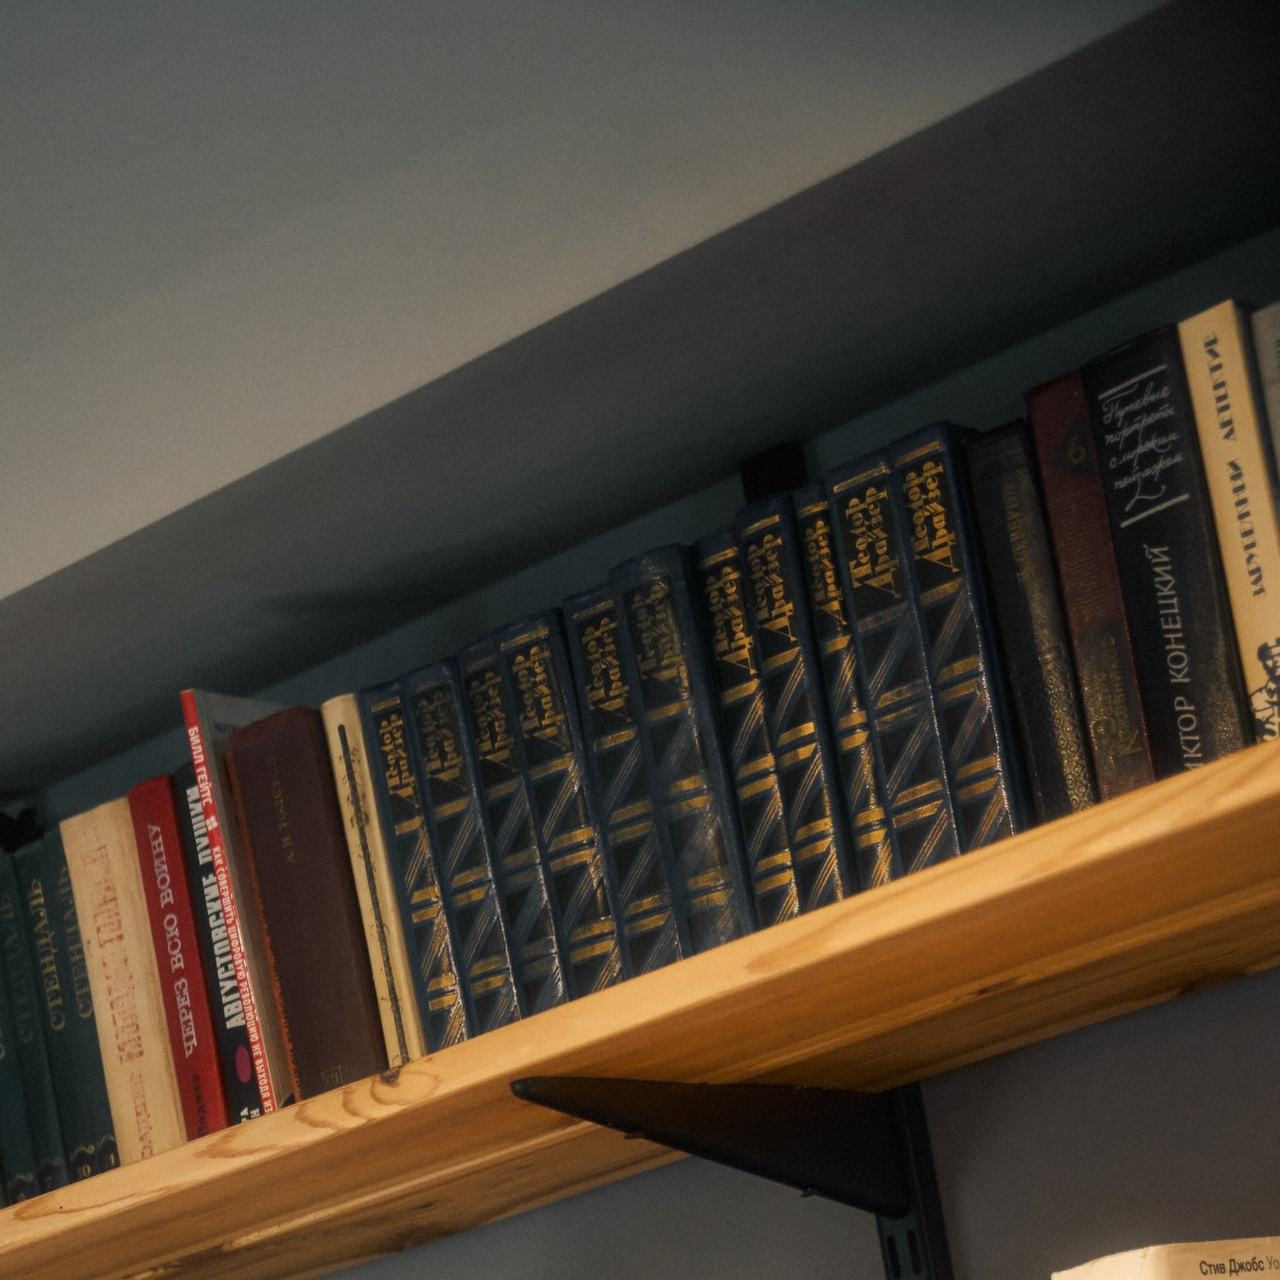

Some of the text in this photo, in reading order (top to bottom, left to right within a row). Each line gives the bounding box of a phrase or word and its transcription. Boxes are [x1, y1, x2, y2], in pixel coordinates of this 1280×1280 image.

[1144, 545, 1201, 772] ИКТОР КОНЕЦКИЙ
[187, 725, 215, 807] БИЛЛ ГЕЙТС
[28, 877, 66, 1031] СТЕНДАЛЬ
[147, 823, 198, 1059] ЧЕРЕЗ ВСЮ ВОЙНУ
[216, 866, 236, 927] СОВЕРШИТЬ
[228, 925, 247, 980] ЦИФРОВУЮ
[239, 979, 260, 1044] РЕВОЛЮЦИЮ
[255, 1058, 272, 1100] ВЫХОДЯ
[1198, 1255, 1265, 1277] Стив Джобс
